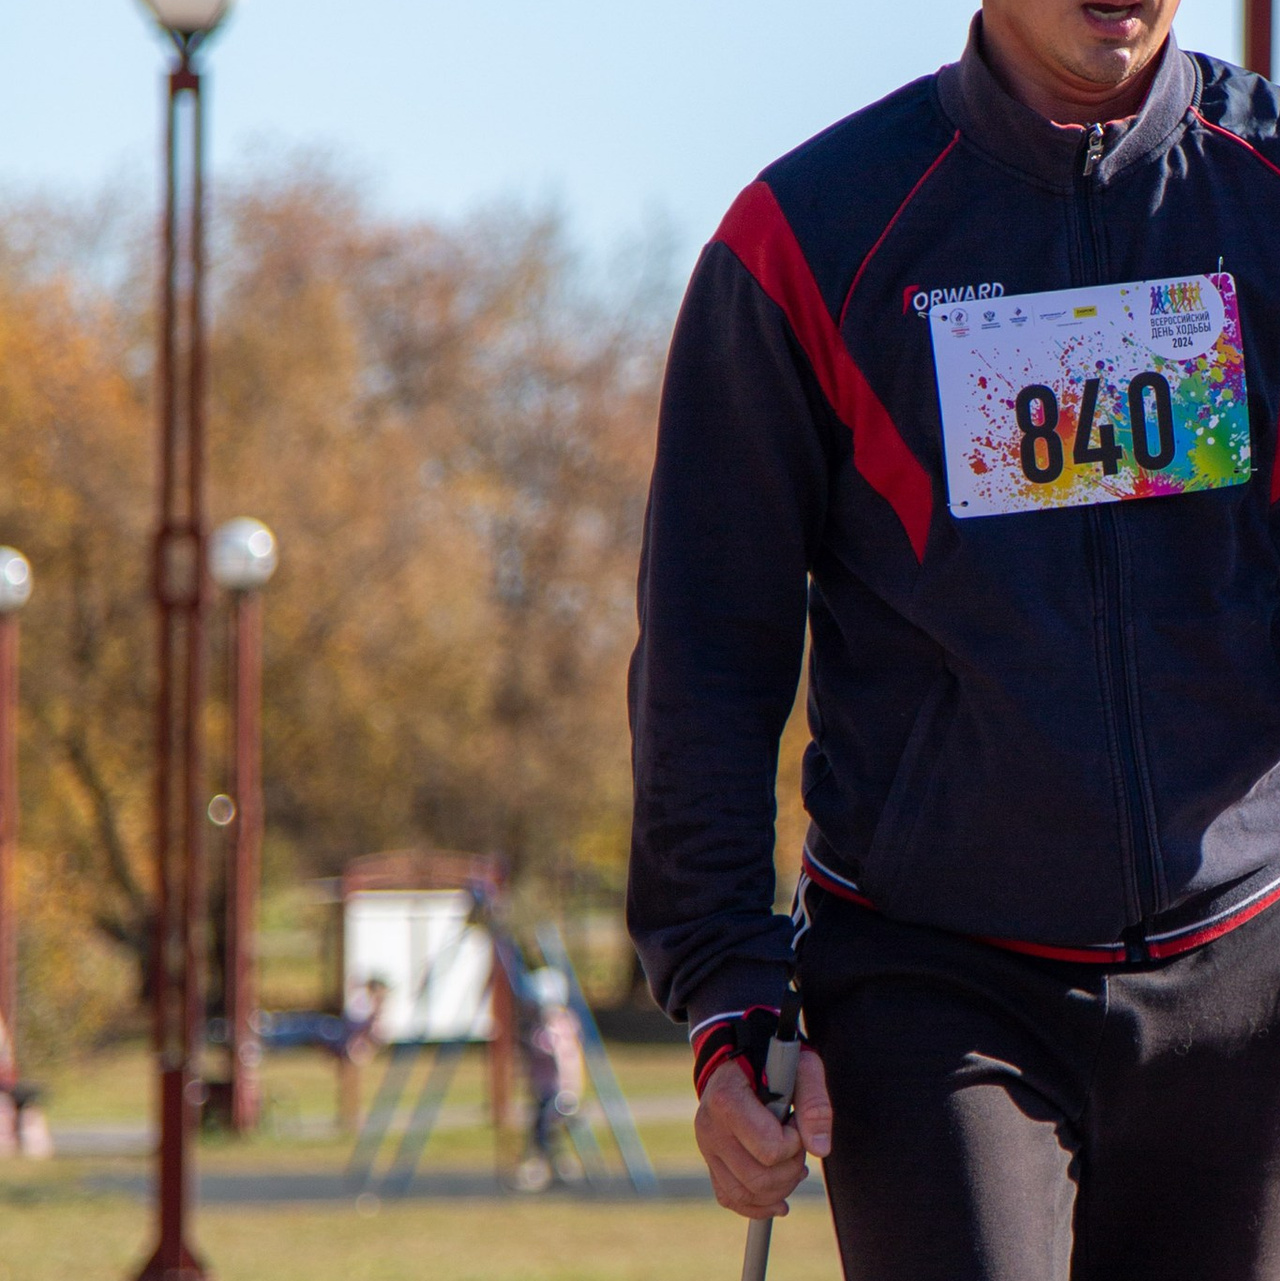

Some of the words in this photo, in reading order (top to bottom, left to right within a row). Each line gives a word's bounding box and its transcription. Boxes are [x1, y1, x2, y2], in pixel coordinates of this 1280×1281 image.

[902, 282, 1004, 315] FORWARD
[1150, 311, 1210, 327] ВСЕРОССИЙСКИЙ
[1151, 326, 1174, 339] ДЕНЬ
[1176, 322, 1211, 336] ХОДЬБЫ
[1172, 336, 1194, 349] 2024
[1015, 371, 1176, 484] 840
